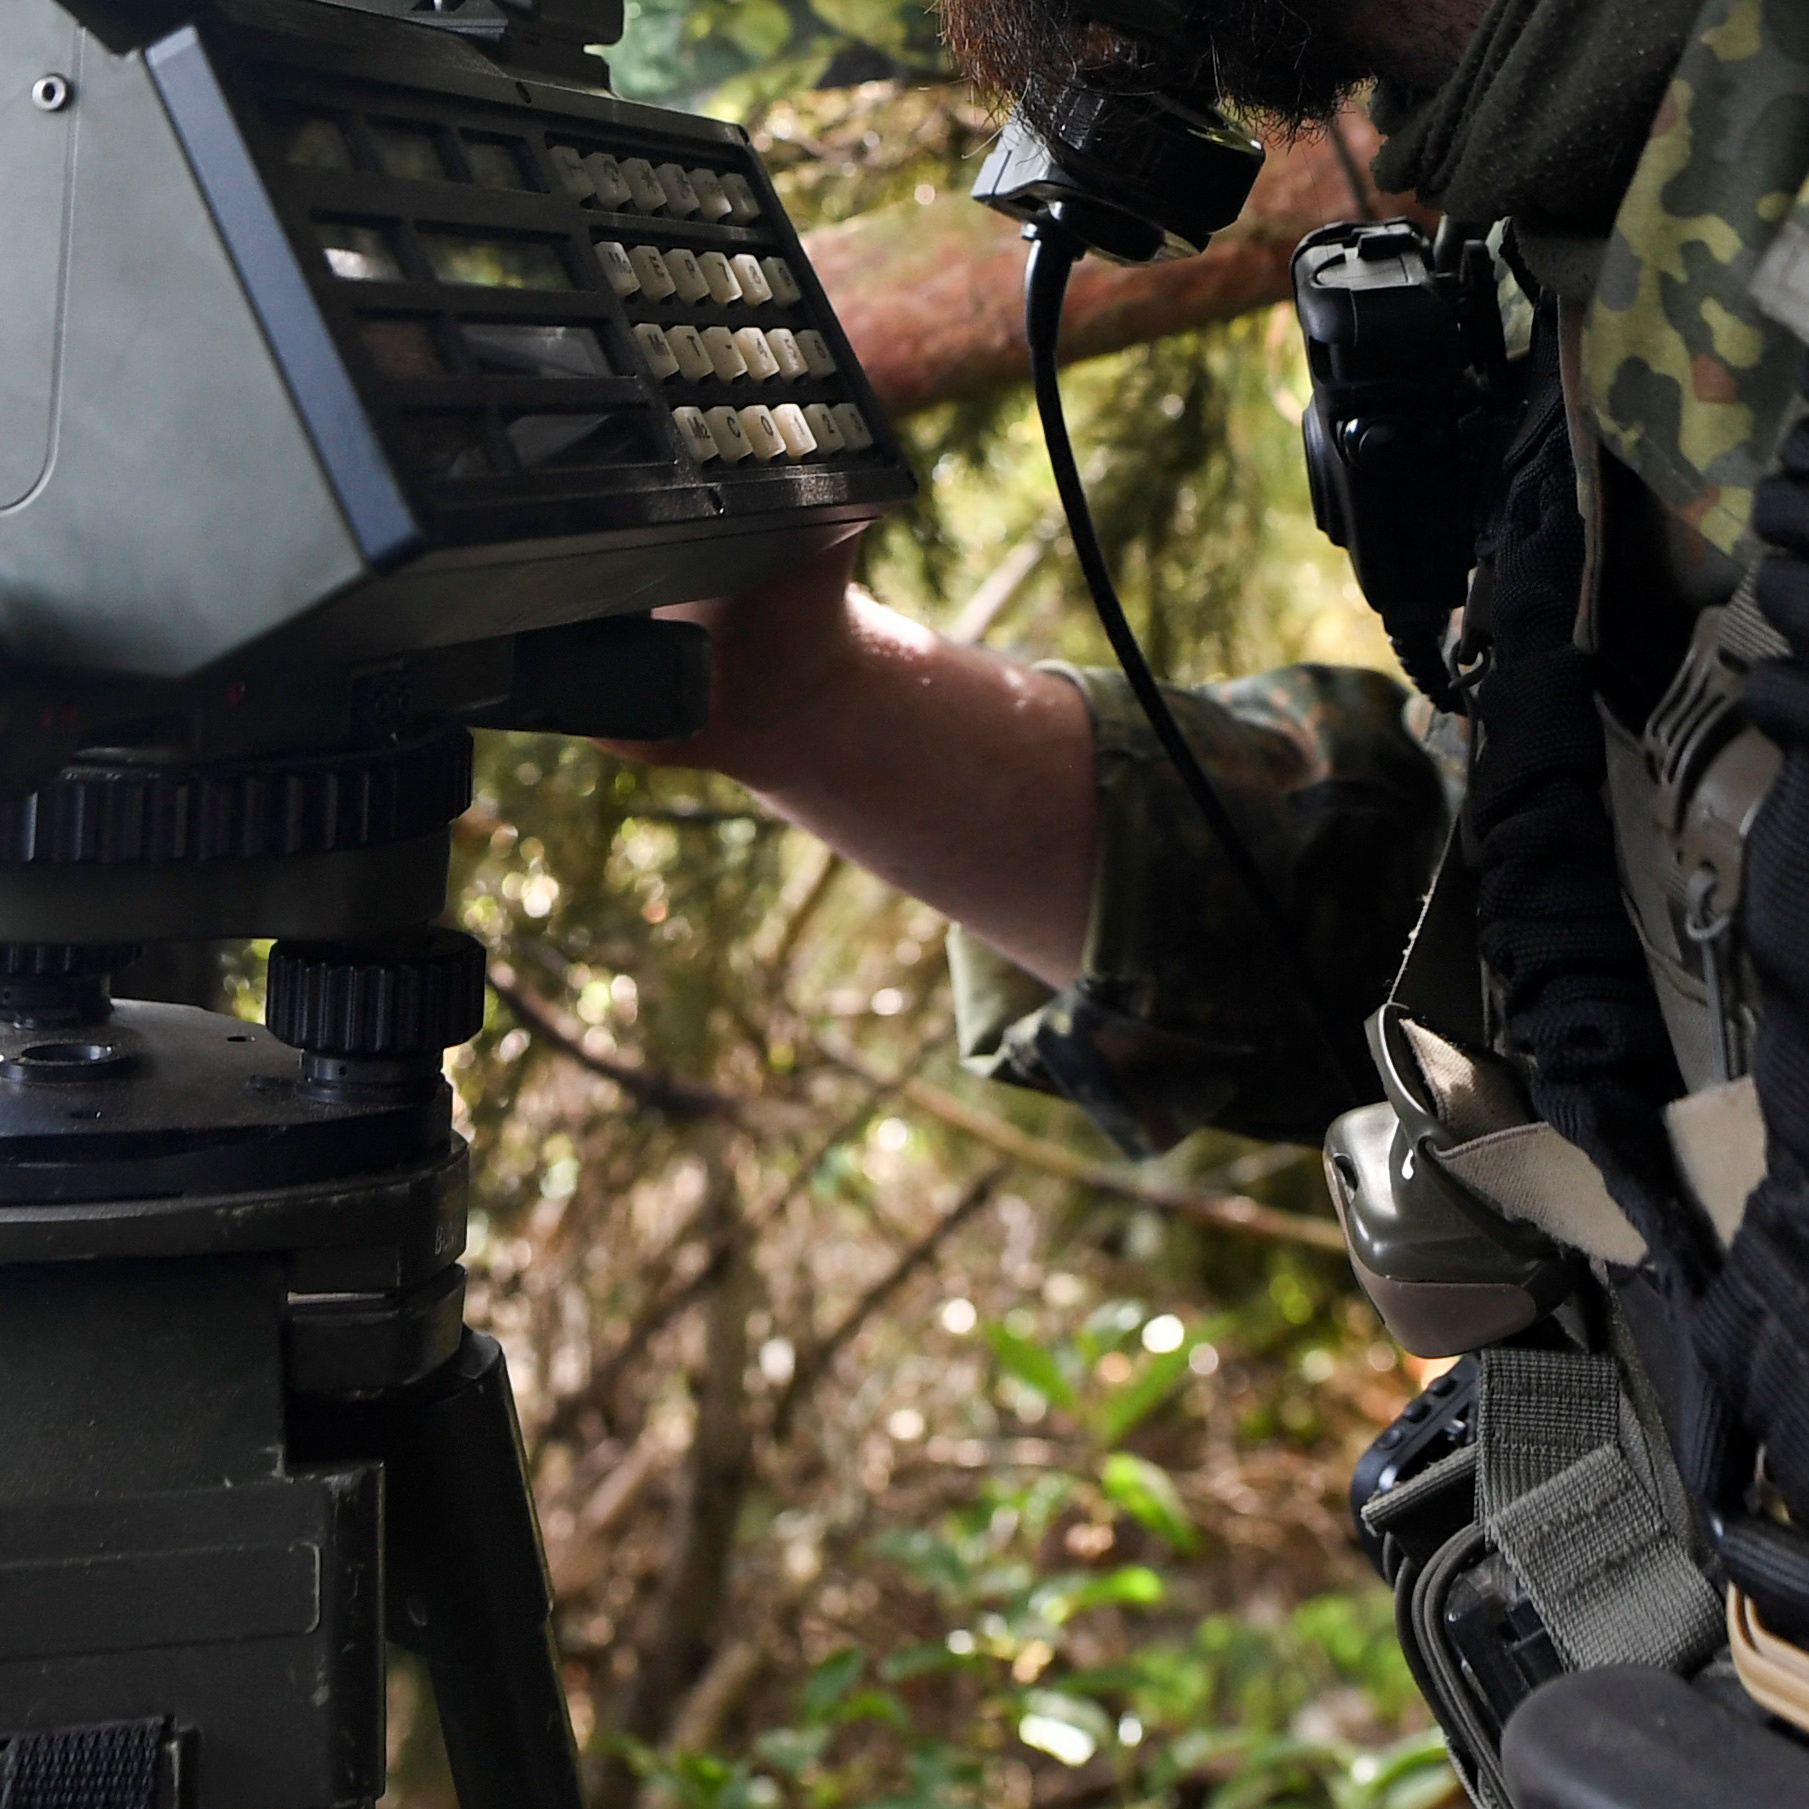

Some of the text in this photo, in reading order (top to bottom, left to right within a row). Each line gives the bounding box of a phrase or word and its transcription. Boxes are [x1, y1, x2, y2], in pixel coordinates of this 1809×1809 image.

[717, 262, 729, 282] 7
[749, 265, 762, 284] 8
[686, 335, 701, 358] T
[755, 337, 769, 359] 4
[727, 416, 741, 437] C
[822, 413, 835, 435] 2
